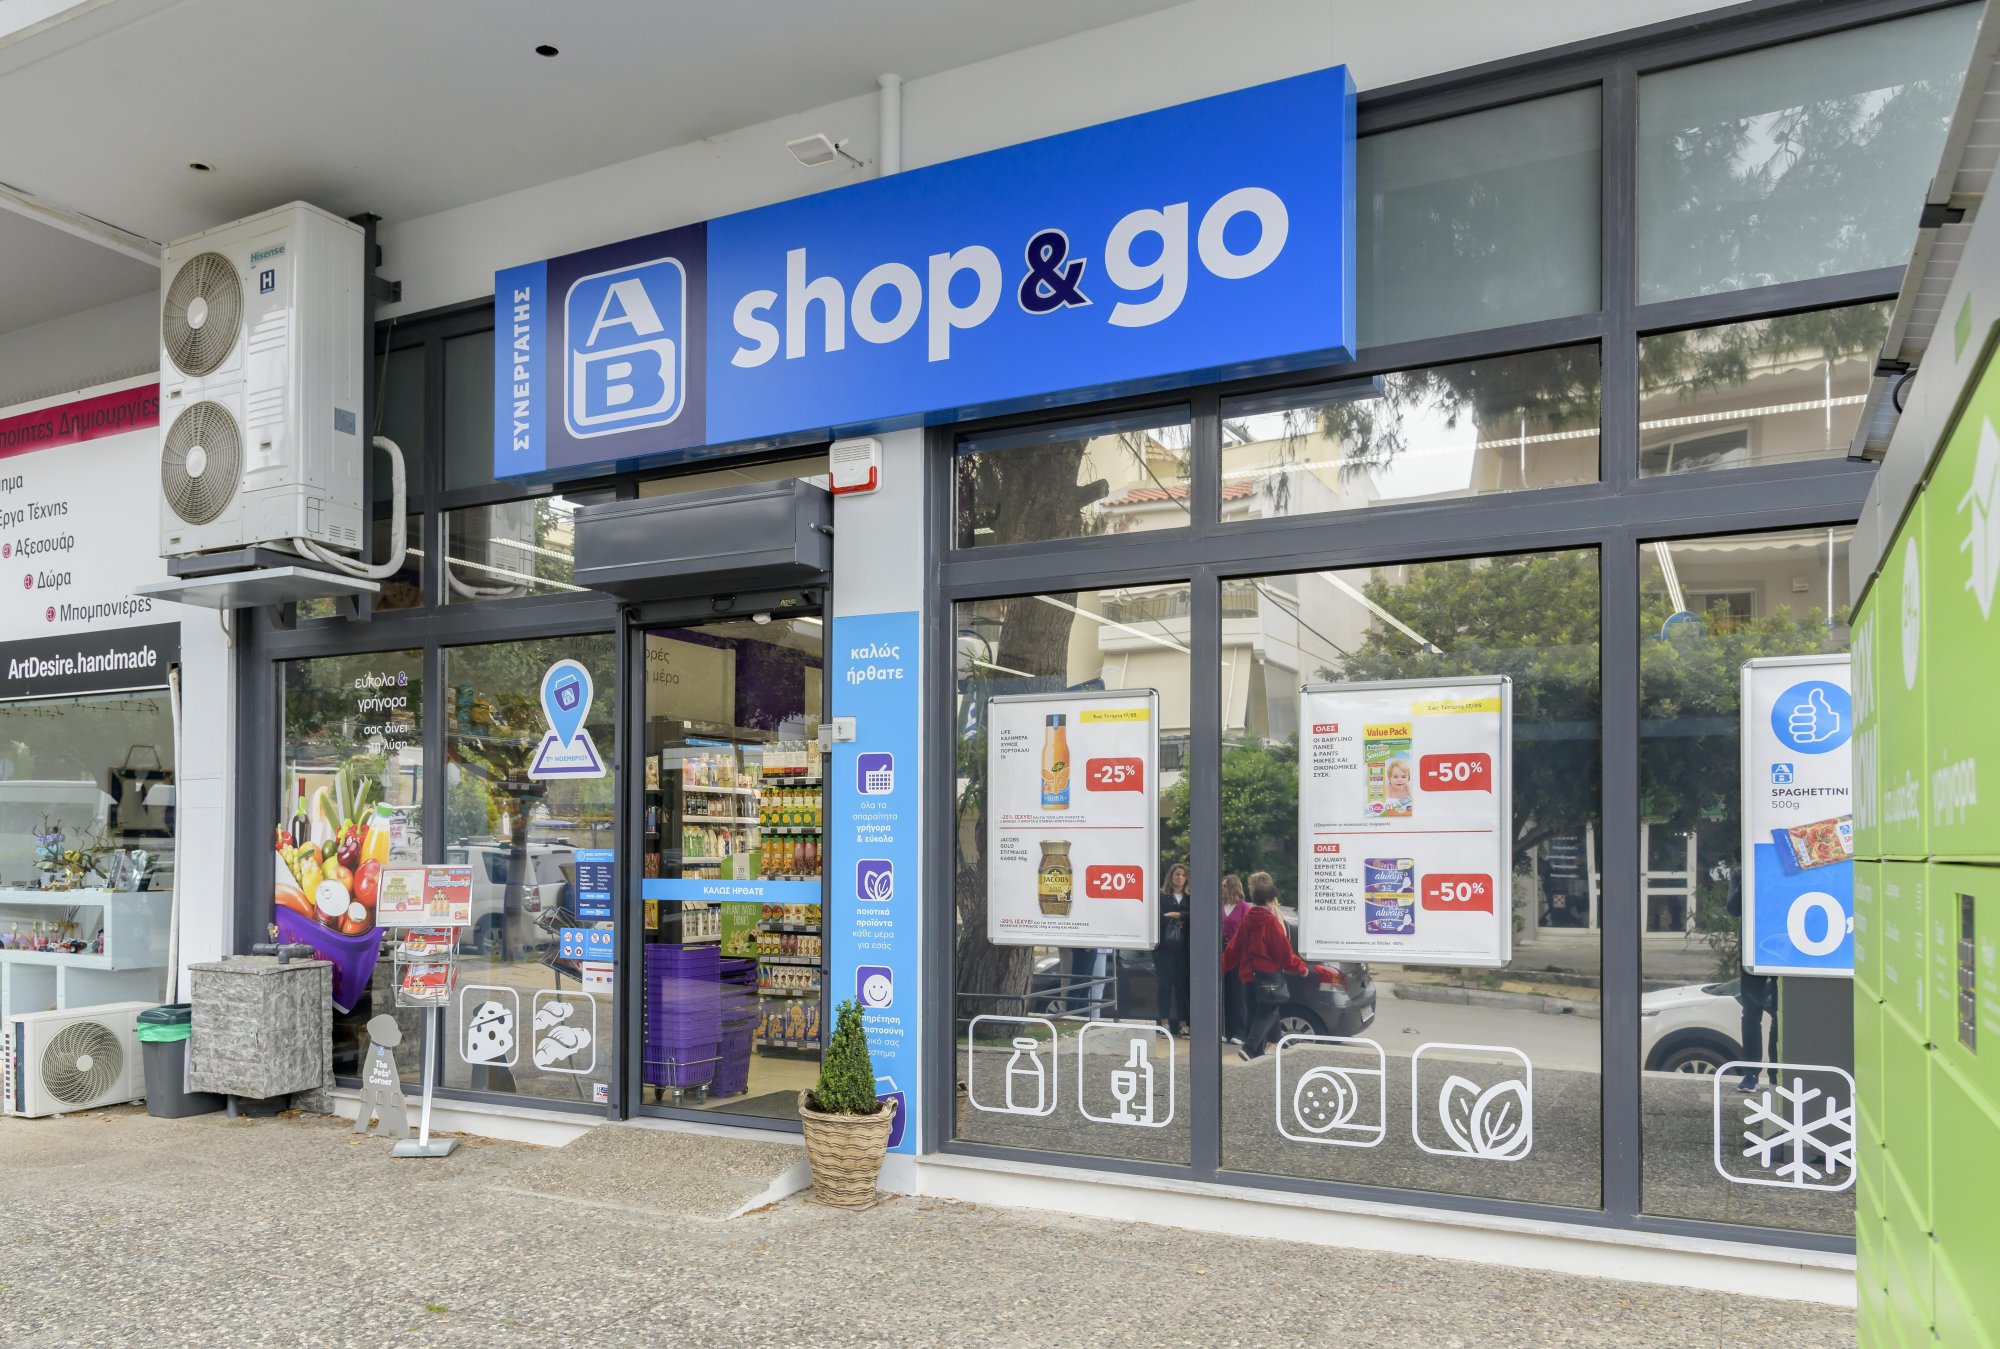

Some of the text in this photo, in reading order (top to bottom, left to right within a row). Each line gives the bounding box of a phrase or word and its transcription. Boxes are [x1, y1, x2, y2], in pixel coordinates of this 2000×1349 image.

[250, 246, 285, 263] Hisense
[731, 186, 1290, 369] shop & go
[513, 286, 532, 451] ΣΥΝΕΡΓΑΤΗΣ
[59, 394, 159, 436] Δημιουργίες
[0, 475, 23, 494] ημα
[27, 501, 68, 521] Τέχνης
[15, 533, 75, 558] Αξεσουάρ
[37, 570, 72, 590] Δώρα
[60, 596, 152, 623] Μπομπονιέρες
[850, 643, 900, 660] καλώς
[8, 646, 157, 680] ArtDesire.handmade
[355, 671, 408, 689] εύκολα &
[846, 666, 904, 684] ήρθατε
[357, 695, 406, 712] γρήγορα
[364, 722, 408, 735] σας δίνει
[1367, 727, 1407, 736] Value Pack
[383, 739, 408, 751] λύση
[1093, 765, 1135, 783] -25%
[1428, 762, 1482, 782] -50%
[1772, 788, 1848, 796] SPAGHETTINI
[860, 801, 875, 809] όλα
[1772, 801, 1800, 810] 500g
[852, 812, 898, 822] απαραίτητα
[856, 823, 891, 833] γρήγορα
[857, 834, 893, 843] & εύκολα
[1092, 873, 1136, 891] -20%
[1375, 871, 1404, 882] always
[703, 886, 764, 896] ΚΑΛΩΣ ΗΡΘΑΤΕ
[1430, 882, 1484, 902] -50%
[726, 904, 740, 915] PLANT
[856, 908, 890, 916] ποιοτικά
[1375, 908, 1404, 918] always
[856, 918, 893, 928] προϊόντα
[852, 930, 894, 940] κάθε μέρα
[857, 941, 891, 950] για εσάς
[862, 1014, 900, 1025] πηρέτηση
[862, 1026, 904, 1037] πιστοσύνη
[884, 1039, 900, 1047] σας
[868, 1050, 896, 1058] στημα
[376, 1060, 387, 1069] The
[369, 1076, 392, 1086] Corner
